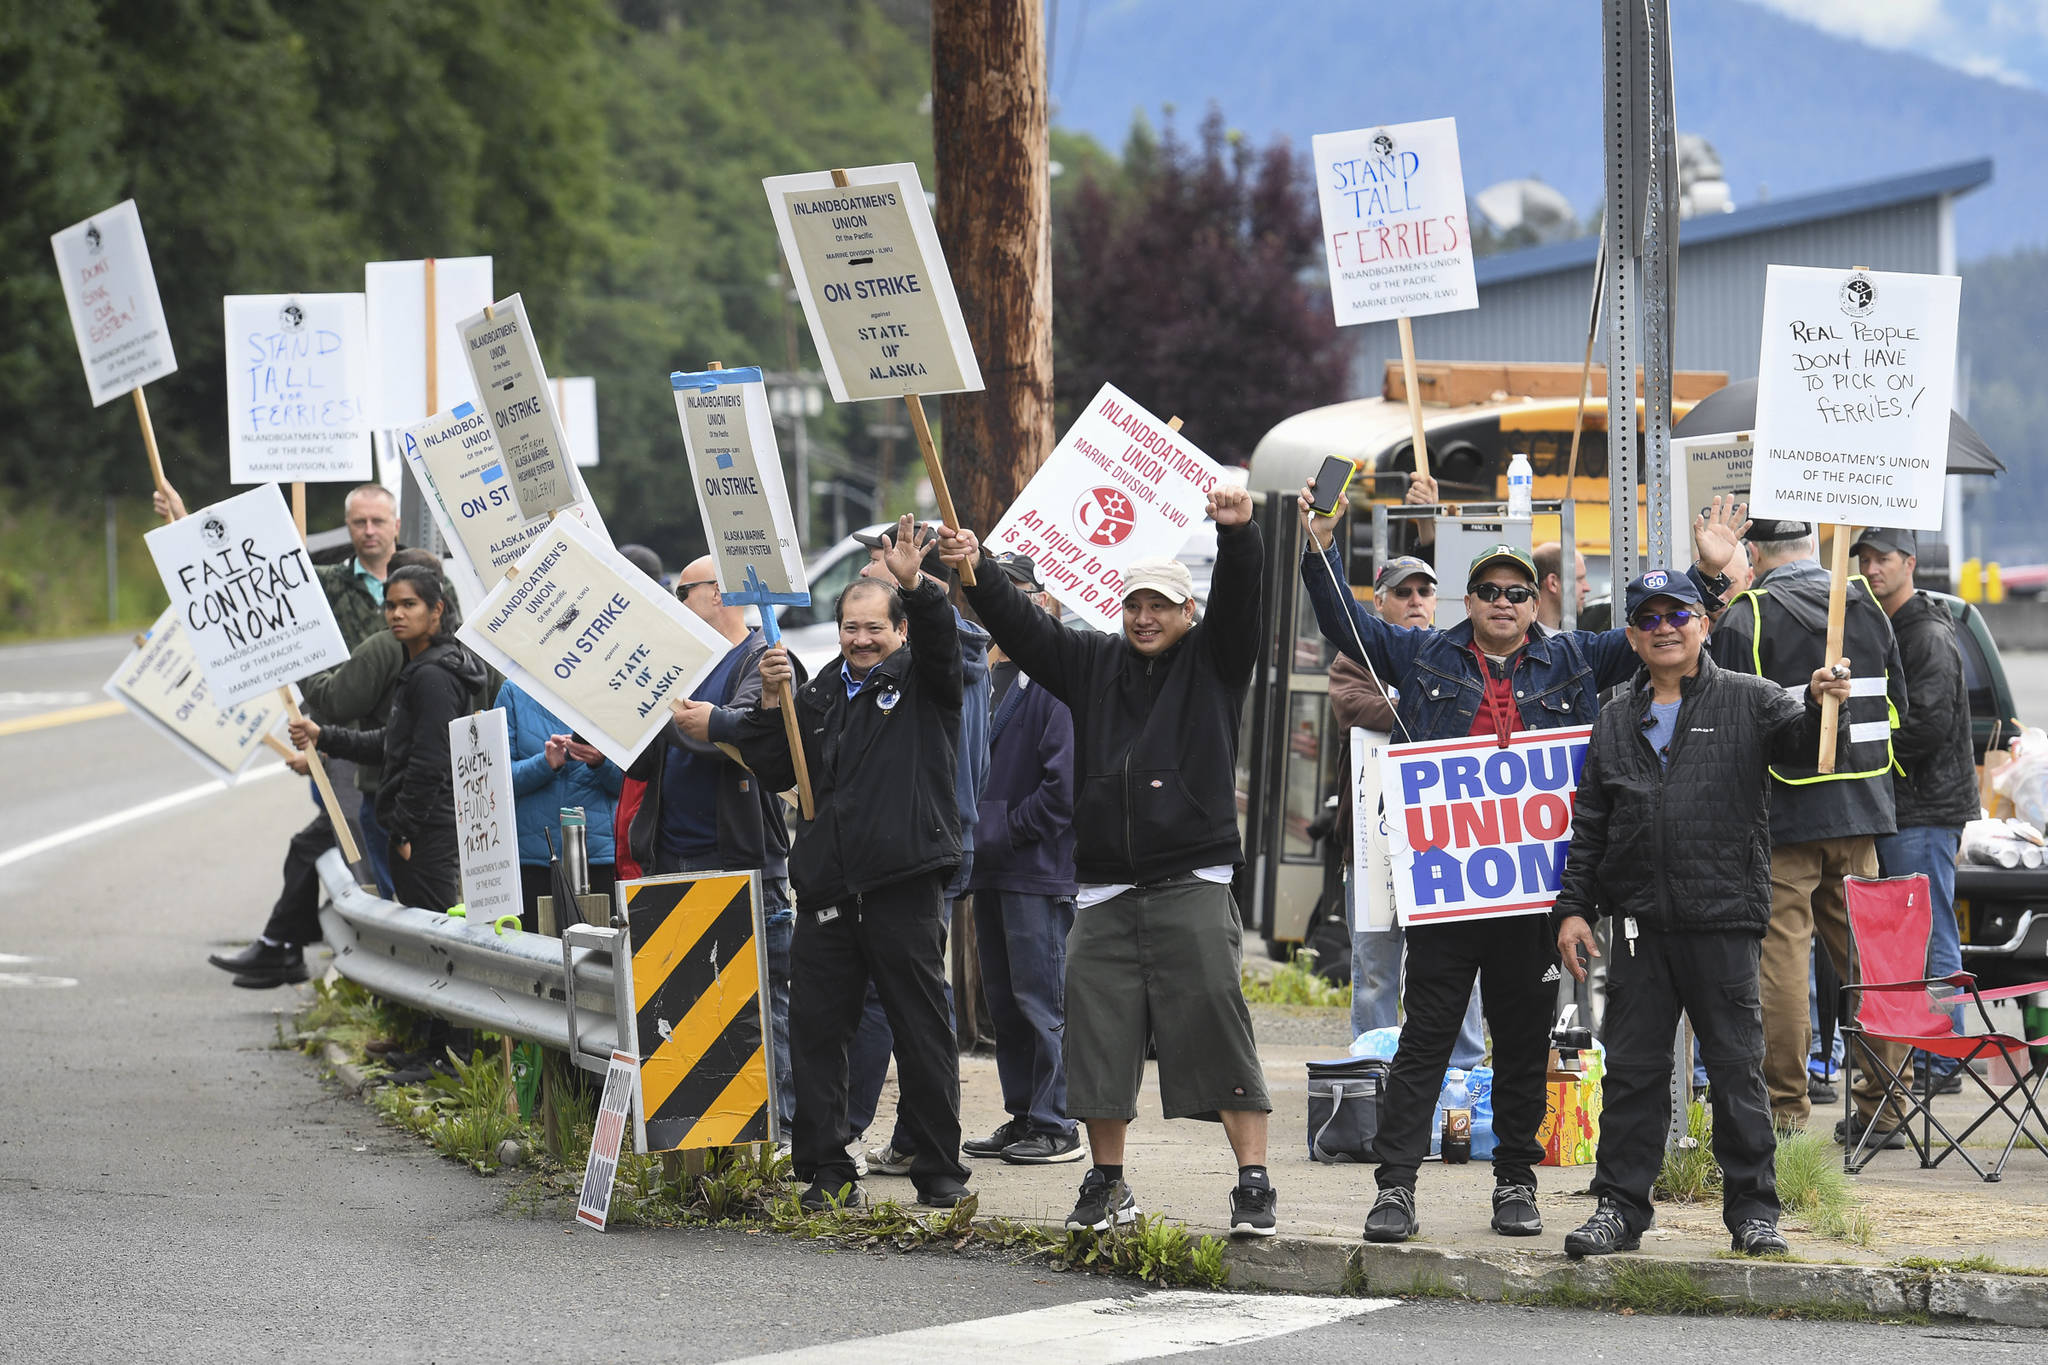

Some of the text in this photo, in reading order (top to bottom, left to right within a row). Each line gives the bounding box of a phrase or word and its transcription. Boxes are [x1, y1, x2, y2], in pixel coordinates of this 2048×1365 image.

[1332, 151, 1420, 190] STAND
[793, 193, 897, 216] INLANDBOATMEN'S
[1344, 181, 1421, 218] TALL
[832, 215, 868, 230] UNION
[844, 233, 854, 241] the
[853, 232, 874, 240] Pacific
[1332, 215, 1458, 268] FERRIES
[826, 246, 894, 260] MARINE DIVISION ILWU
[1341, 257, 1461, 280] INLANDBOATMEN'S UNION
[823, 274, 922, 303] ON STRIKE
[1369, 274, 1437, 291] OF THE PACIFIC
[1351, 297, 1388, 309] MARINE
[1434, 289, 1458, 300] ILWU
[870, 311, 891, 319] against
[469, 321, 518, 352] INLANDBOATMEN'S
[857, 324, 910, 341] STATE
[1790, 320, 1920, 346] REAL PEOPLE
[248, 330, 343, 363] STAND
[489, 343, 508, 361] UNION
[881, 344, 901, 358] OF
[1864, 348, 1907, 367] HAVE
[869, 362, 928, 380] ALASKA
[1802, 373, 1914, 391] TO PICK ON
[248, 364, 326, 403] TALL
[495, 396, 542, 429] ON STRIKE
[687, 394, 742, 408] INLANDBOATMEN'S
[423, 413, 485, 448] INLANDBOA
[707, 412, 727, 426] UNION
[241, 431, 359, 443] INLANDBOATMEN'S UNION
[1098, 398, 1218, 495] INLANDBOATMEN'S
[267, 445, 334, 455] OF THE PACIFIC
[513, 453, 533, 469] ALASKA
[531, 446, 551, 464] MARINE
[1769, 448, 1930, 469] INLANDBOATMEN’S UNION
[249, 463, 285, 472] MARINE
[330, 461, 353, 470] ILWU
[517, 459, 556, 483] HIGHWAY SYSTEM
[1121, 444, 1168, 485] UNION
[1727, 460, 1753, 470] UNIO
[705, 476, 759, 497] ON STRIKE
[1073, 437, 1191, 529] MARINE DIVISION ILWU
[1803, 469, 1894, 486] OF THE PACIFIC
[461, 494, 488, 518] ON
[1775, 489, 1918, 509] MARINE DIVISION, ILWU
[490, 532, 527, 554] ALASKA
[723, 529, 766, 541] ALASKA MARINE
[1018, 508, 1040, 531] An
[1041, 524, 1085, 565] Injury
[1082, 554, 1103, 576] to
[725, 545, 750, 556] HIGHWAY
[749, 544, 773, 555] SYSTEM
[177, 537, 266, 595] FAIR
[1001, 524, 1123, 620] is an Injury to All
[187, 547, 310, 631] CONTRACT
[486, 541, 569, 634] INLANDBOATMEN'S
[576, 586, 590, 601] ILWU
[1648, 577, 1665, 587] 50
[525, 580, 557, 614] UNION
[543, 607, 553, 617] the
[550, 589, 568, 608] Pacific
[222, 592, 298, 649] NOW!
[291, 618, 321, 636] UNION
[554, 651, 582, 680] ON
[575, 592, 631, 653] STRIKE
[239, 642, 303, 673] OF THE PACIFIC
[603, 642, 621, 662] against
[228, 674, 263, 695] MARINE
[303, 649, 327, 668] ILWU
[608, 643, 651, 691] STATE
[635, 666, 653, 688] OF
[637, 665, 684, 718] ALASKA
[457, 749, 492, 778] SAVE THE
[1405, 790, 1576, 853] UNIO
[1541, 973, 1562, 983] adidas
